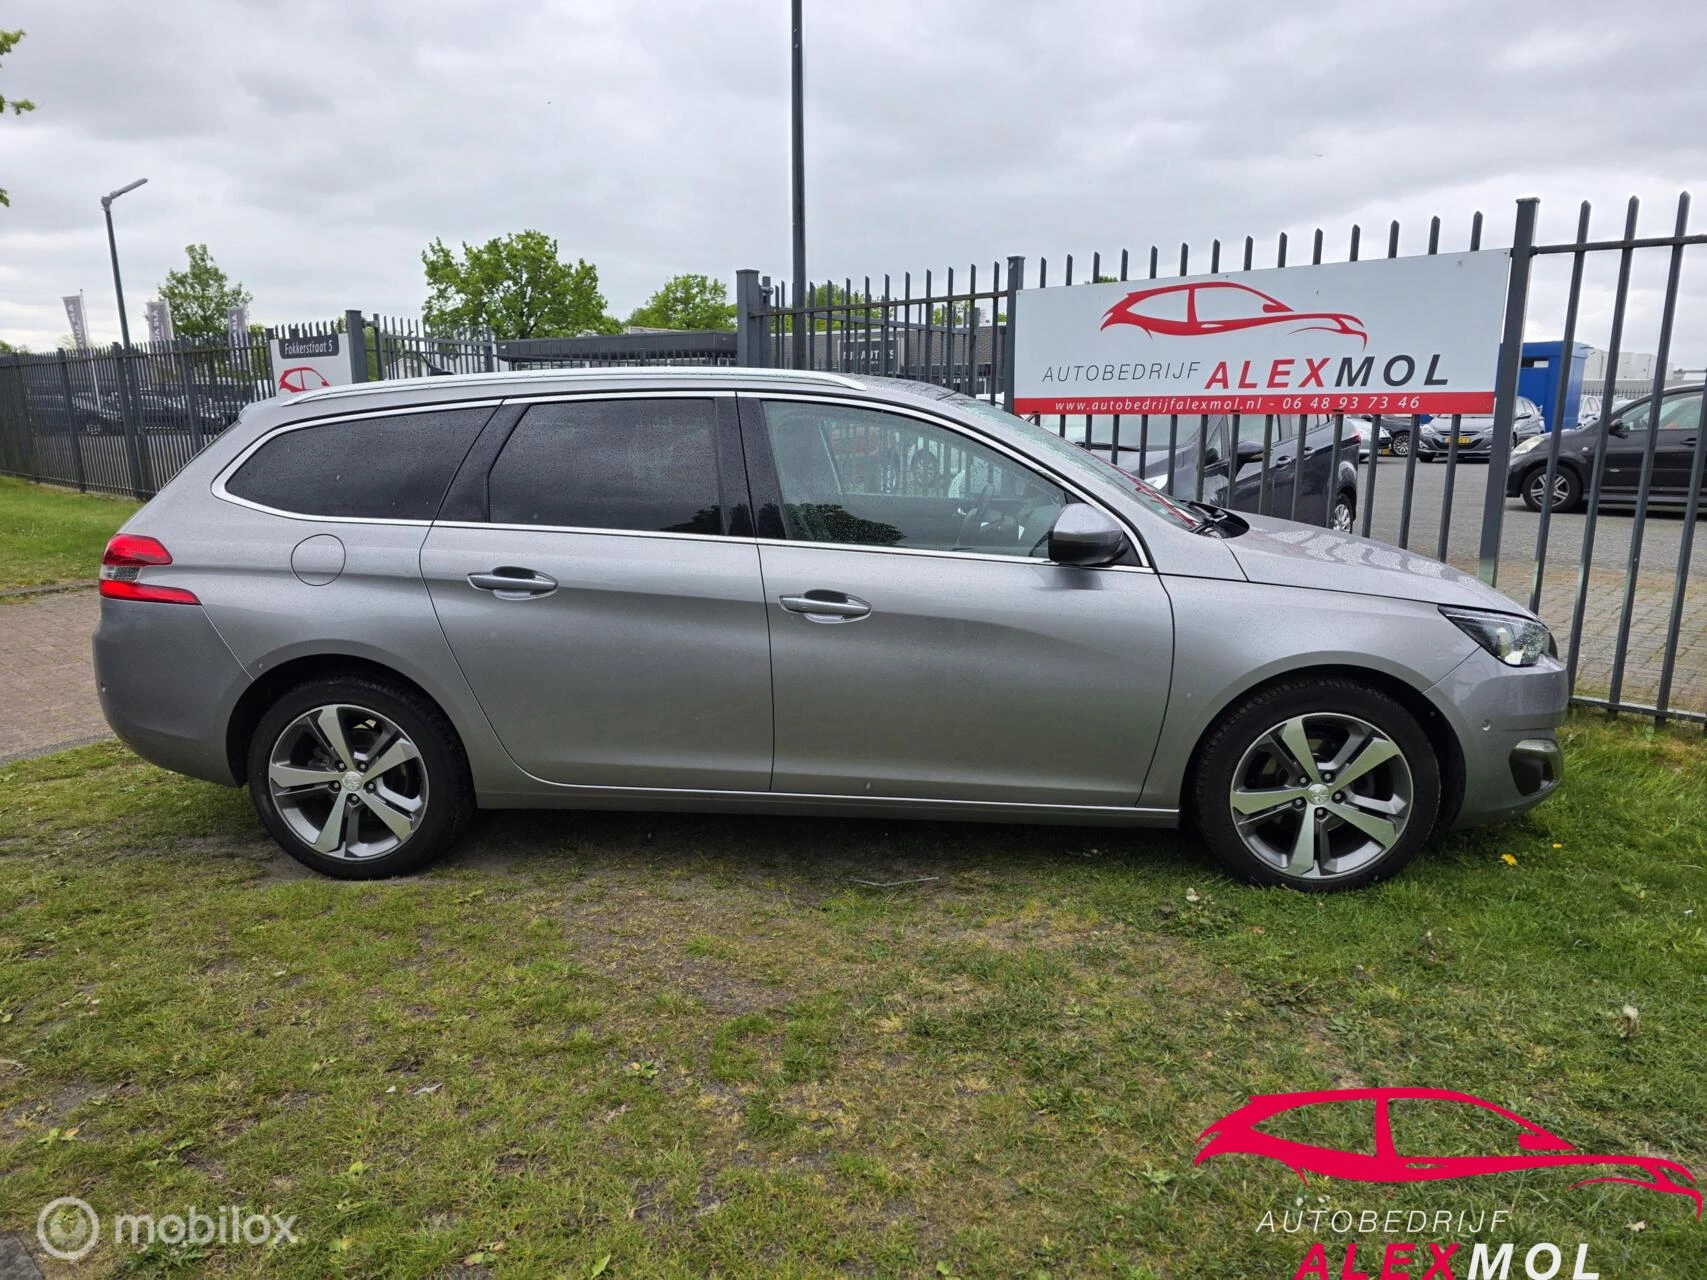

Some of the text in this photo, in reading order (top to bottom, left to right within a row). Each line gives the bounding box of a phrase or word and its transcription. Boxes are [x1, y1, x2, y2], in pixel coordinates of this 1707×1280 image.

[284, 340, 333, 355] Fokkerstraat 5
[1042, 361, 1201, 382] AUTOBEDRIJF
[1055, 397, 1262, 412] www.autobedrijfalexmol.nl
[1282, 396, 1302, 410] 06
[1310, 396, 1330, 409] 48
[1338, 396, 1359, 409] 93
[1368, 396, 1388, 409] 73
[1397, 395, 1420, 409] 46
